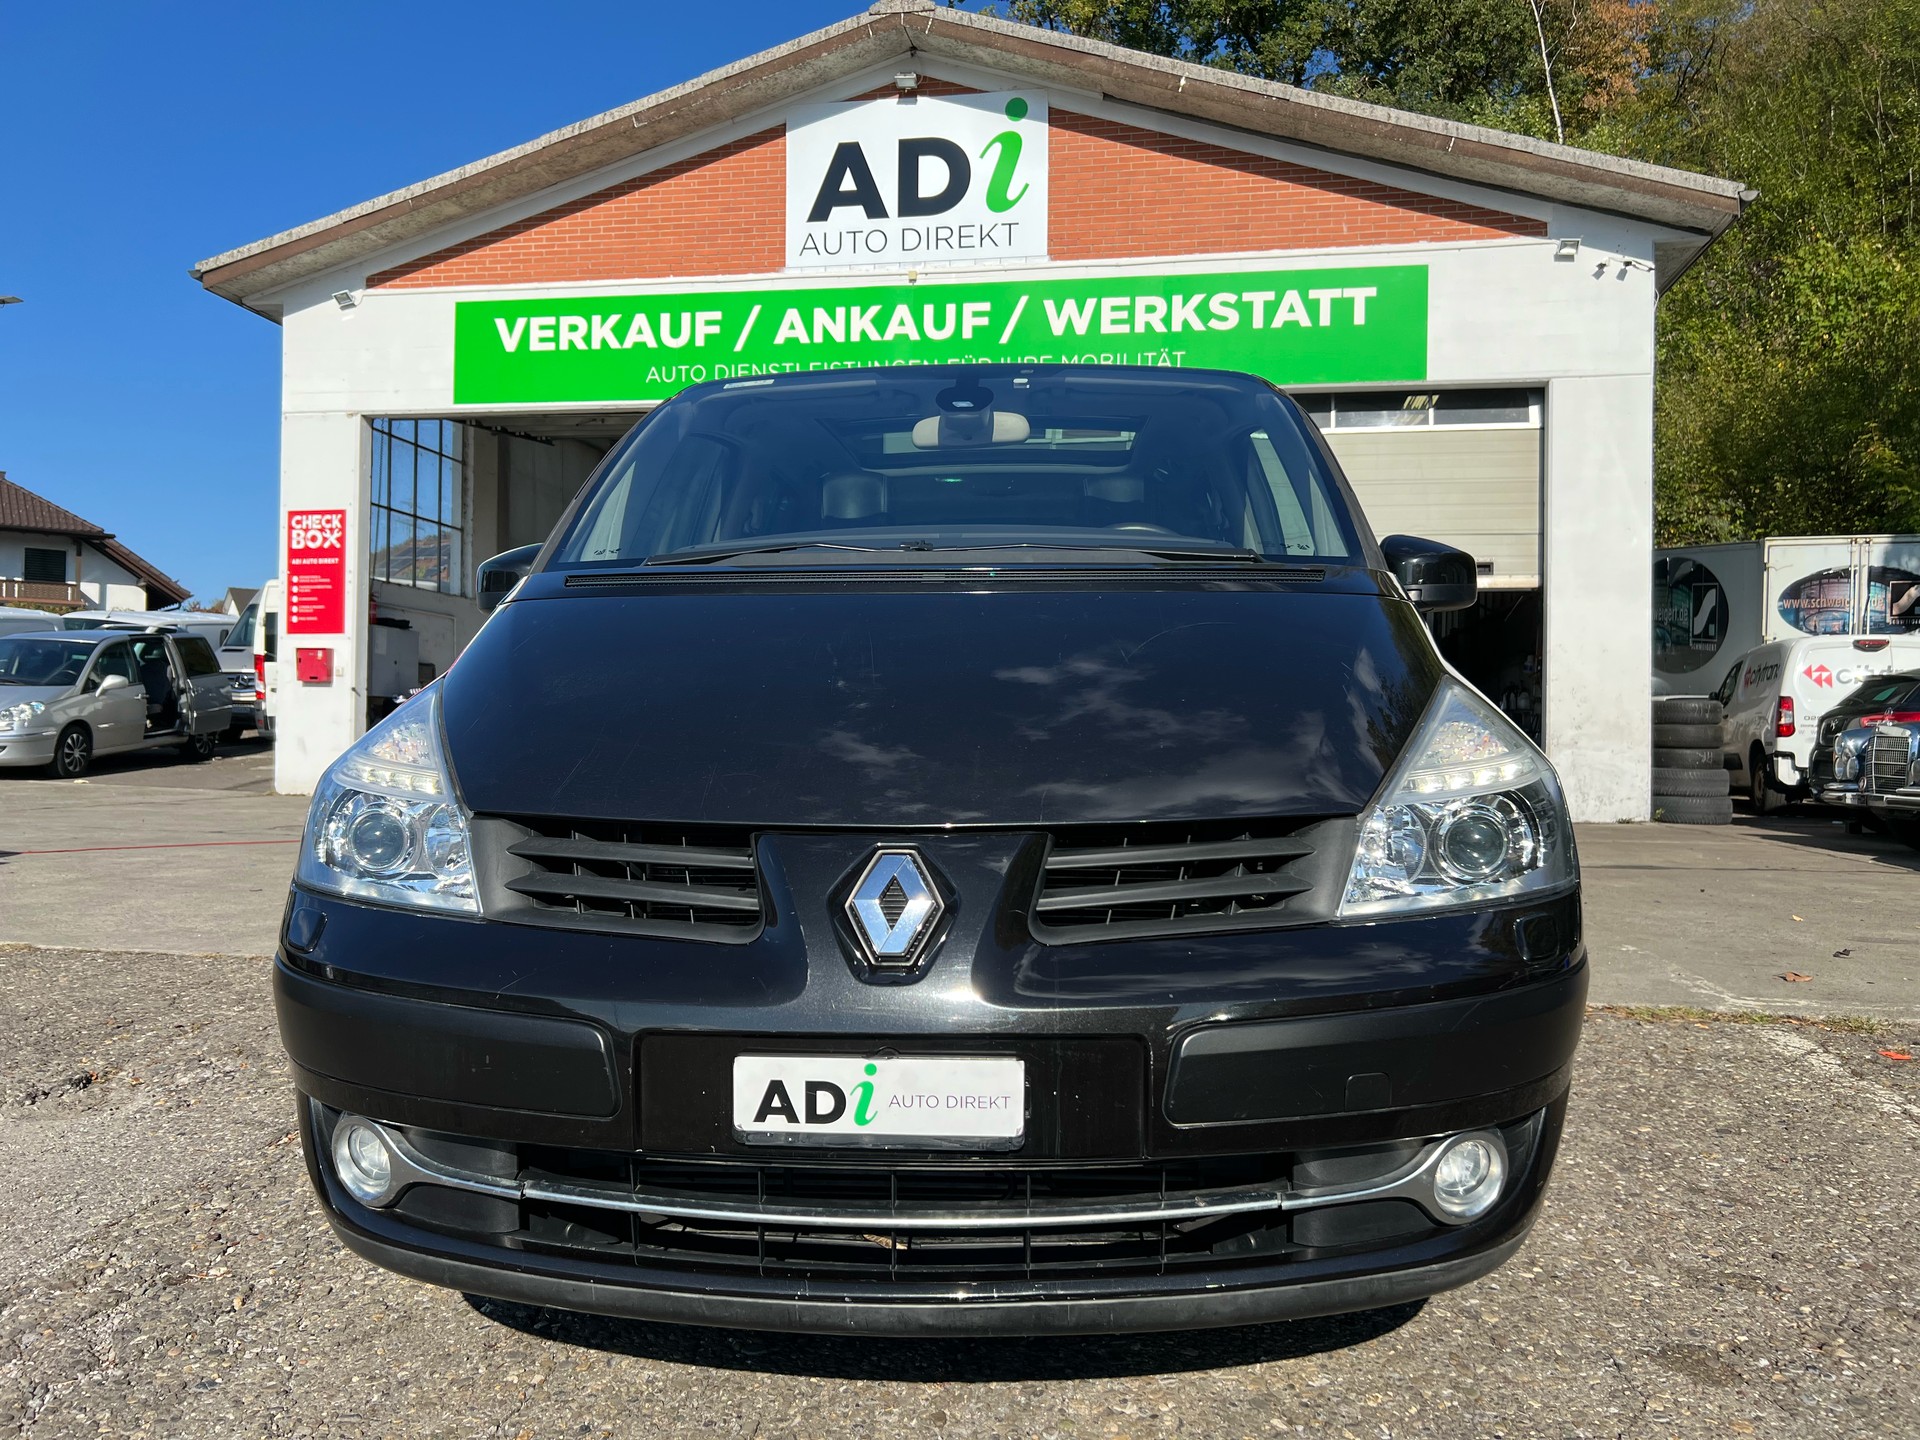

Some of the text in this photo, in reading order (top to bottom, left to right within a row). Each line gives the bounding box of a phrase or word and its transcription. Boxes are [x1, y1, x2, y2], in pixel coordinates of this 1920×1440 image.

[799, 222, 1019, 256] AUTO DIREKT
[494, 311, 722, 352] VERKAUF
[773, 302, 991, 344] ANKAUF
[1043, 287, 1377, 336] WERKSTATT
[645, 364, 707, 384] AUTO
[291, 513, 342, 529] CHECK
[291, 528, 342, 549] BOX
[752, 1063, 1011, 1126] ADi AUTO DIREKT
